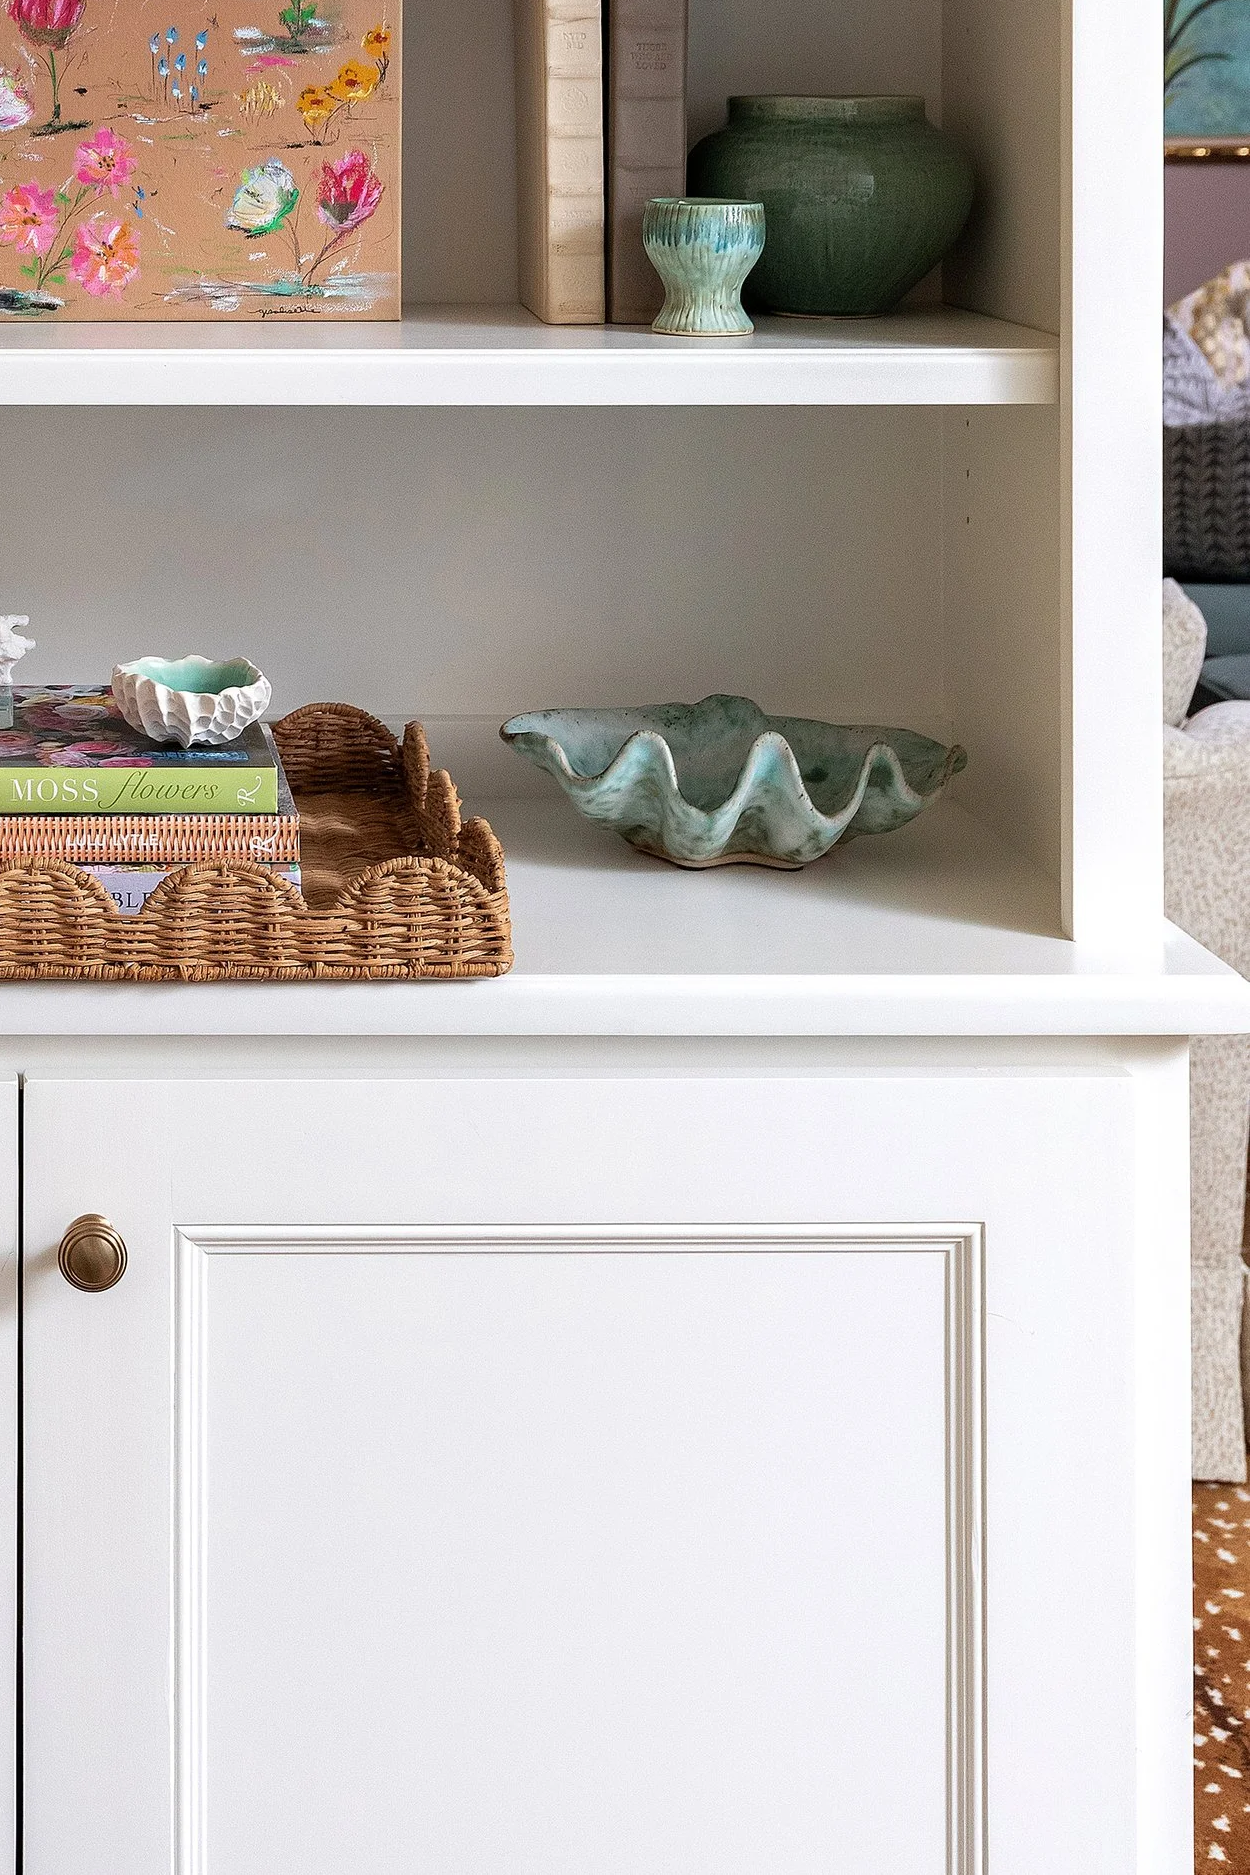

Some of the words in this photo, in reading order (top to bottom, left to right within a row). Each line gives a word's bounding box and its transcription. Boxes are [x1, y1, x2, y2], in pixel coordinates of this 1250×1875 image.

[10, 778, 99, 802] MOSS
[97, 771, 223, 810] flowers
[65, 833, 108, 848] LULU
[113, 833, 159, 848] LYTLE
